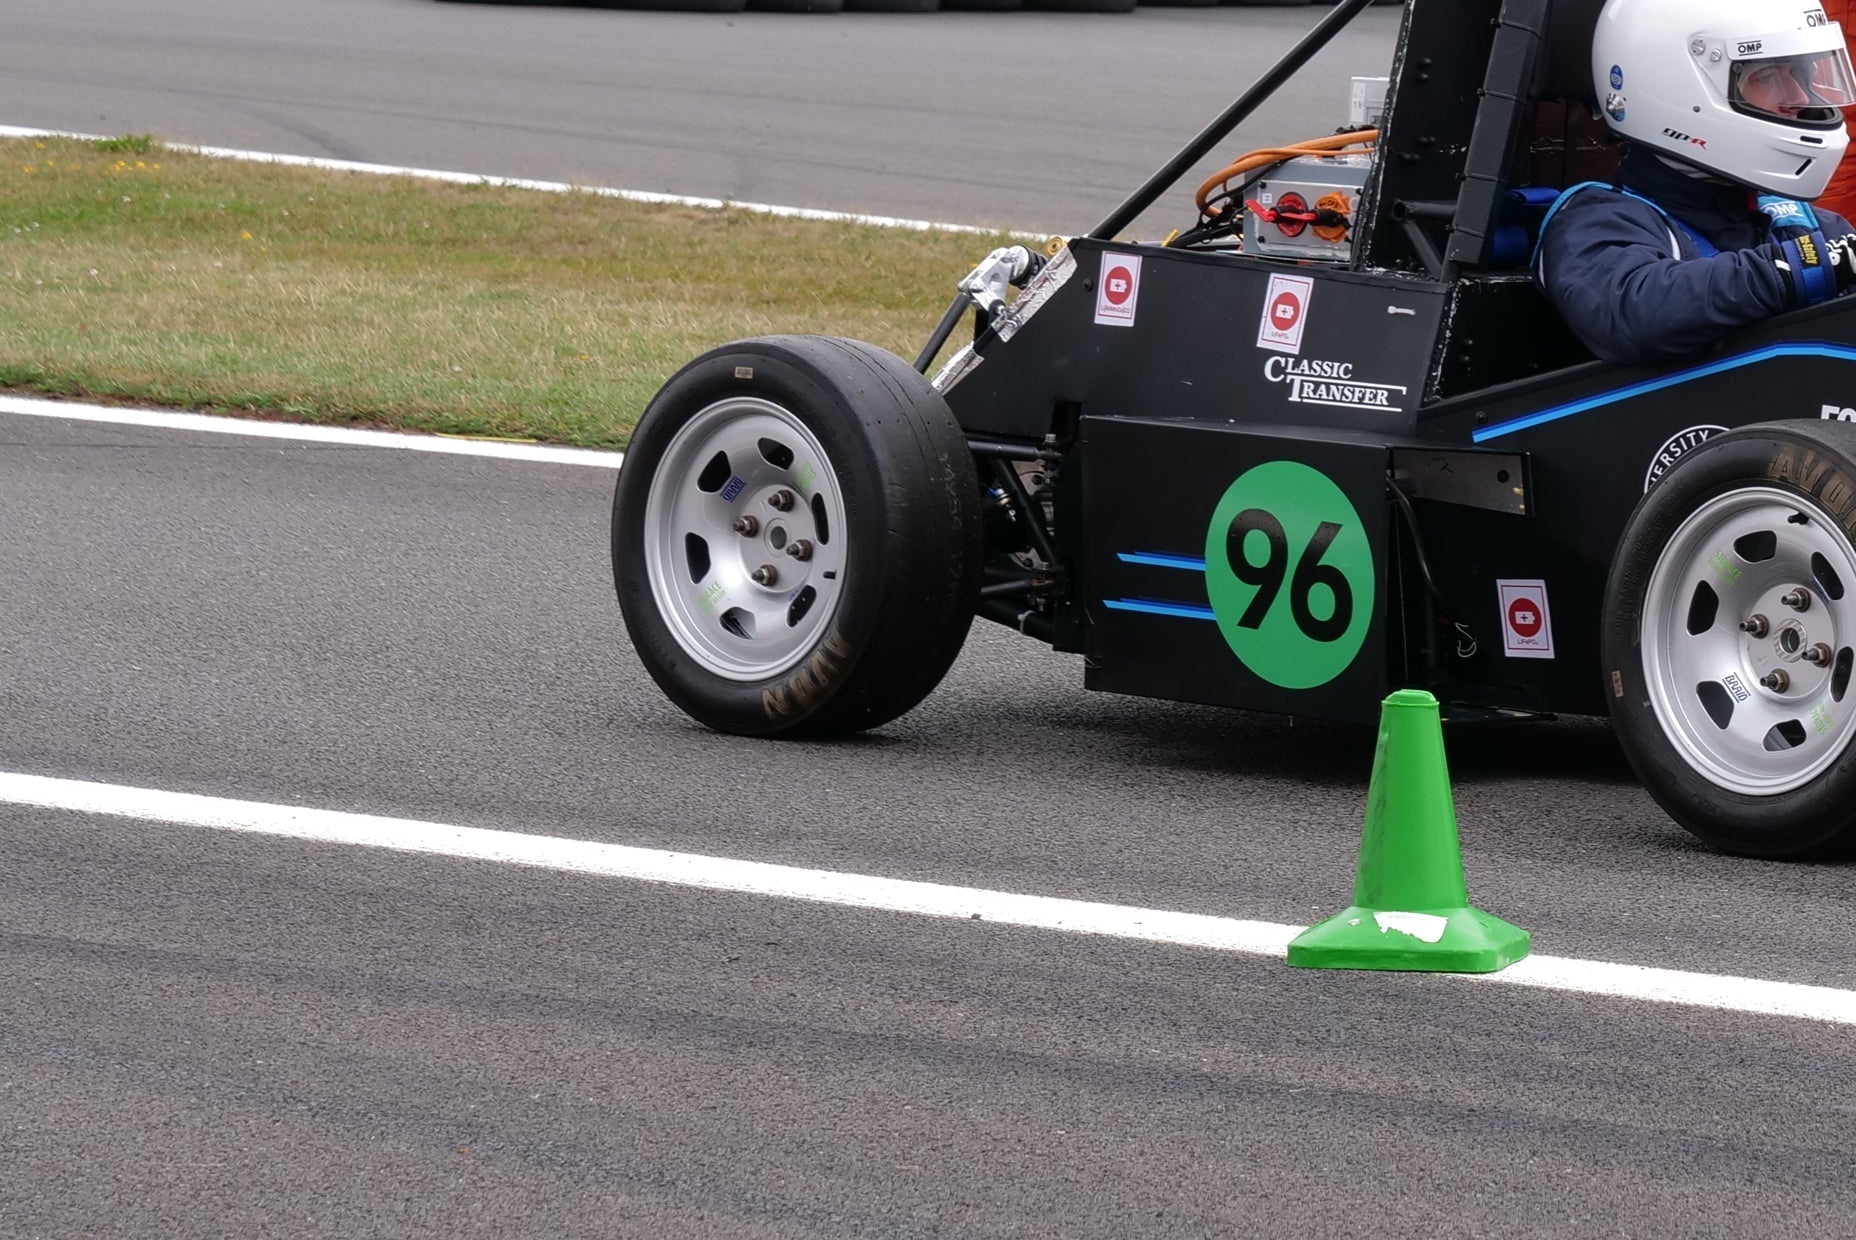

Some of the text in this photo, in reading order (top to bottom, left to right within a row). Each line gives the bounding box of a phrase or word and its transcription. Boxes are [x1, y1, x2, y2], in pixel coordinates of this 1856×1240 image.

[1737, 42, 1763, 54] OMP
[1763, 203, 1799, 217] OMP
[1225, 507, 1354, 643] 96
